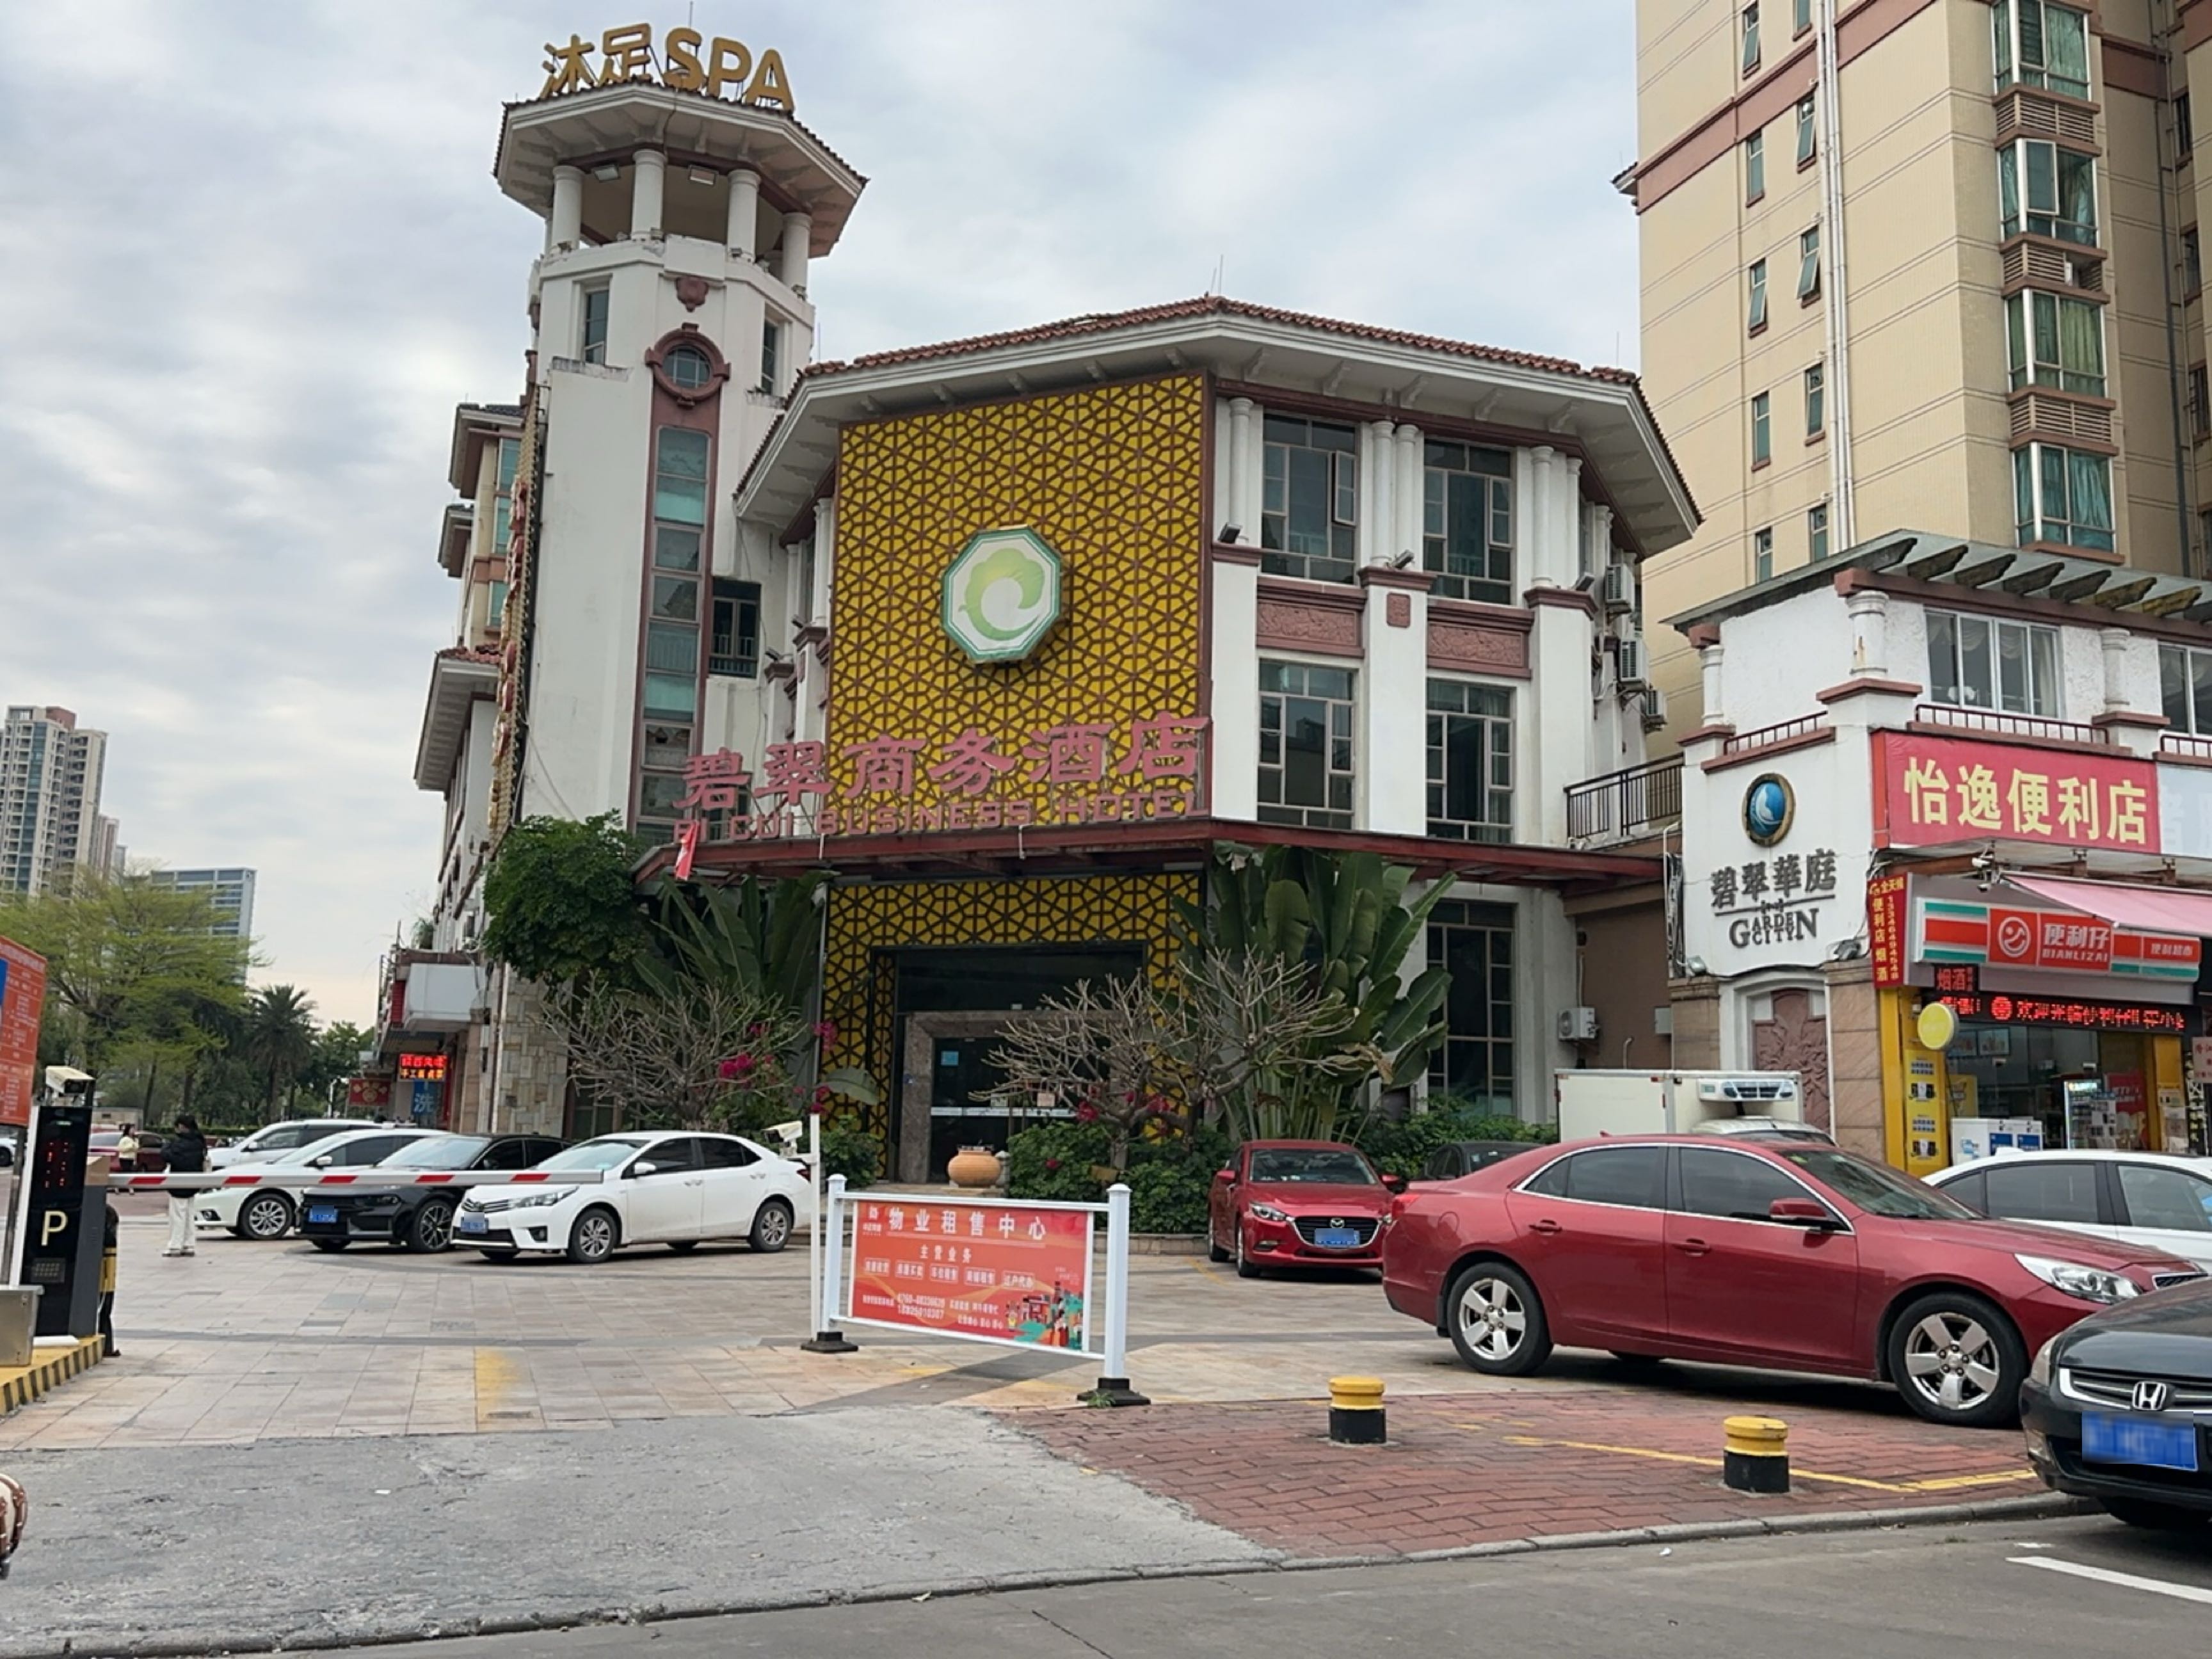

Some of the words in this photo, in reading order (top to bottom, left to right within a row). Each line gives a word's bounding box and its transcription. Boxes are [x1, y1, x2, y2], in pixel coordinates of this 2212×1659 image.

[673, 710, 1209, 811] 碧翠商务酒店
[729, 812, 794, 840] CUI
[819, 800, 1032, 836] BUSINESS
[1059, 789, 1210, 824] HOTEL
[1903, 756, 2147, 845] 怡逸便利店
[1711, 848, 1836, 909] 碧翠華庭
[2044, 922, 2110, 950] 便利仔
[41, 1210, 68, 1246] P
[888, 1206, 1046, 1241] 物业租售中心
